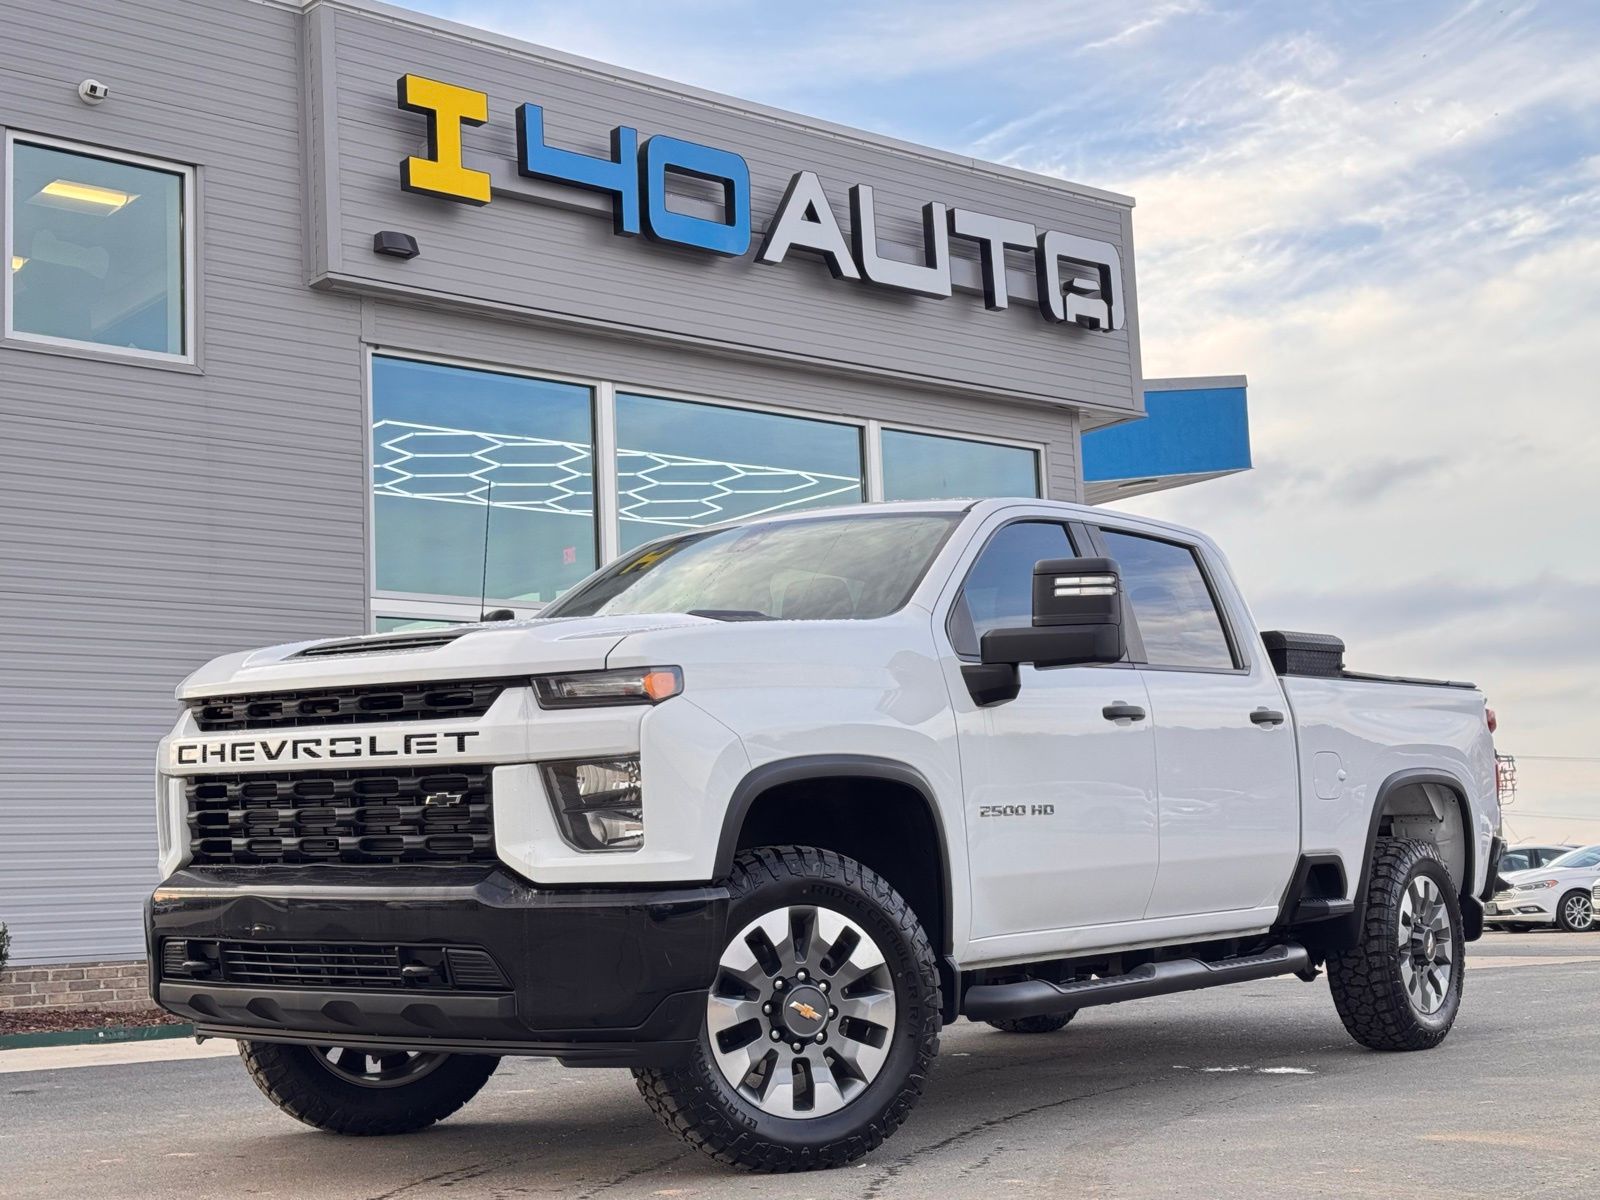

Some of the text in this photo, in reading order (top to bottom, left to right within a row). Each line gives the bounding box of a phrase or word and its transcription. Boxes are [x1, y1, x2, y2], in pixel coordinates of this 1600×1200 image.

[178, 731, 479, 764] CHEVROLET
[980, 804, 1054, 817] 2500 HD
[694, 1042, 758, 1129] BLACKHAW
